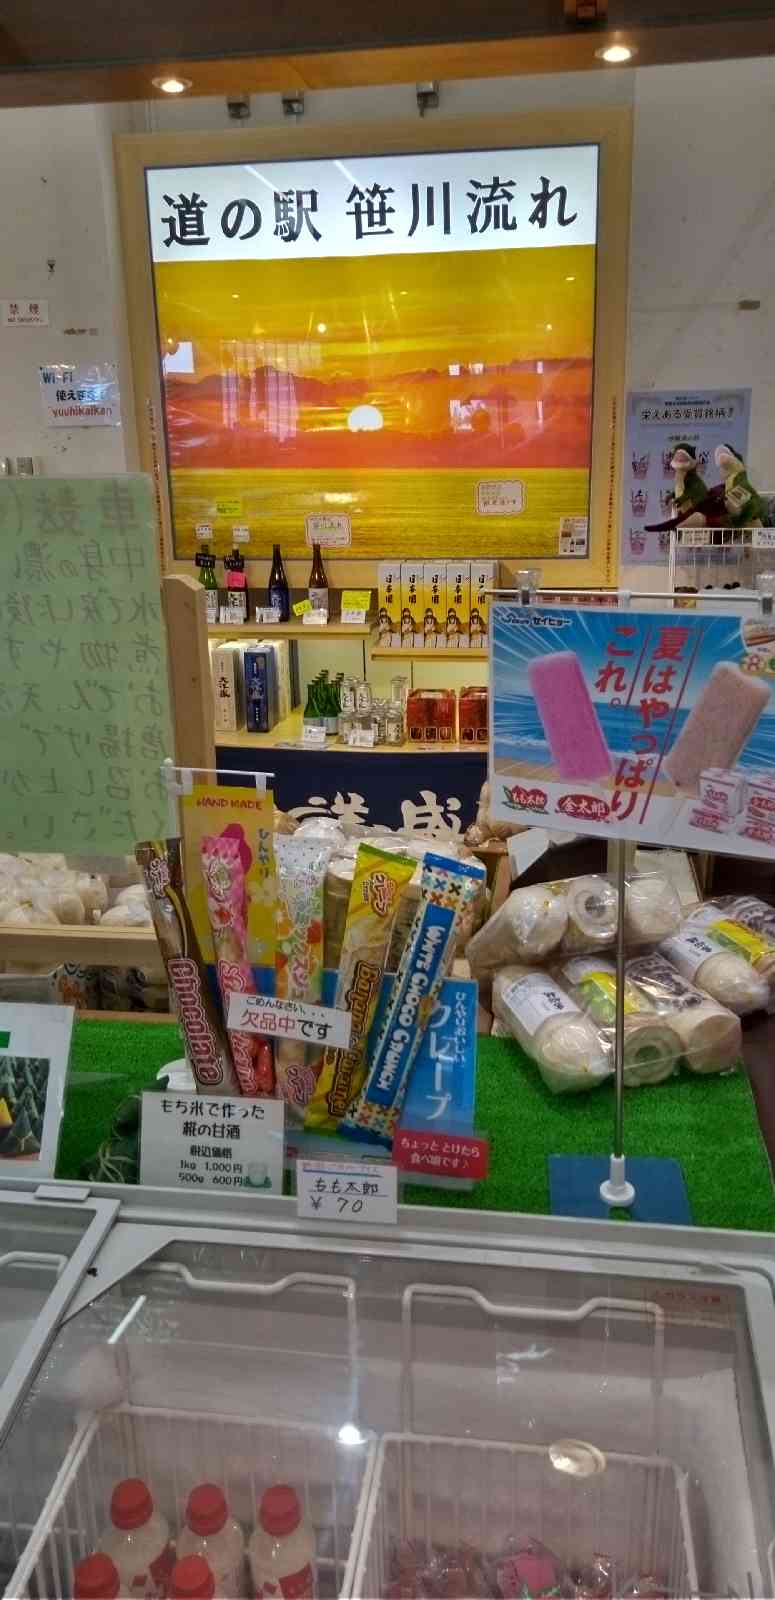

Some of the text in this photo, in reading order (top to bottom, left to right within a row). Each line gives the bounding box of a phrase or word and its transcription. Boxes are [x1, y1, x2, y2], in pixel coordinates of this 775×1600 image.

[161, 176, 577, 247] 道の駅 笹川流れ
[595, 626, 637, 709] これ。
[611, 627, 691, 821] 夏はやっぱり
[196, 796, 263, 811] HAND MADE
[398, 971, 429, 1028] CHOCO
[168, 958, 222, 1086] Chocolate
[240, 1009, 333, 1040] 欠品中です
[376, 1027, 411, 1092] CRUNCH
[426, 1004, 457, 1121] クレープ
[160, 1099, 265, 1120] もち米で作った
[190, 1144, 232, 1159] 税込価格
[401, 1137, 441, 1153] ちょっと
[180, 1160, 197, 1171] 1kg
[314, 1177, 379, 1196] もも太郎
[337, 1197, 363, 1213] 70
